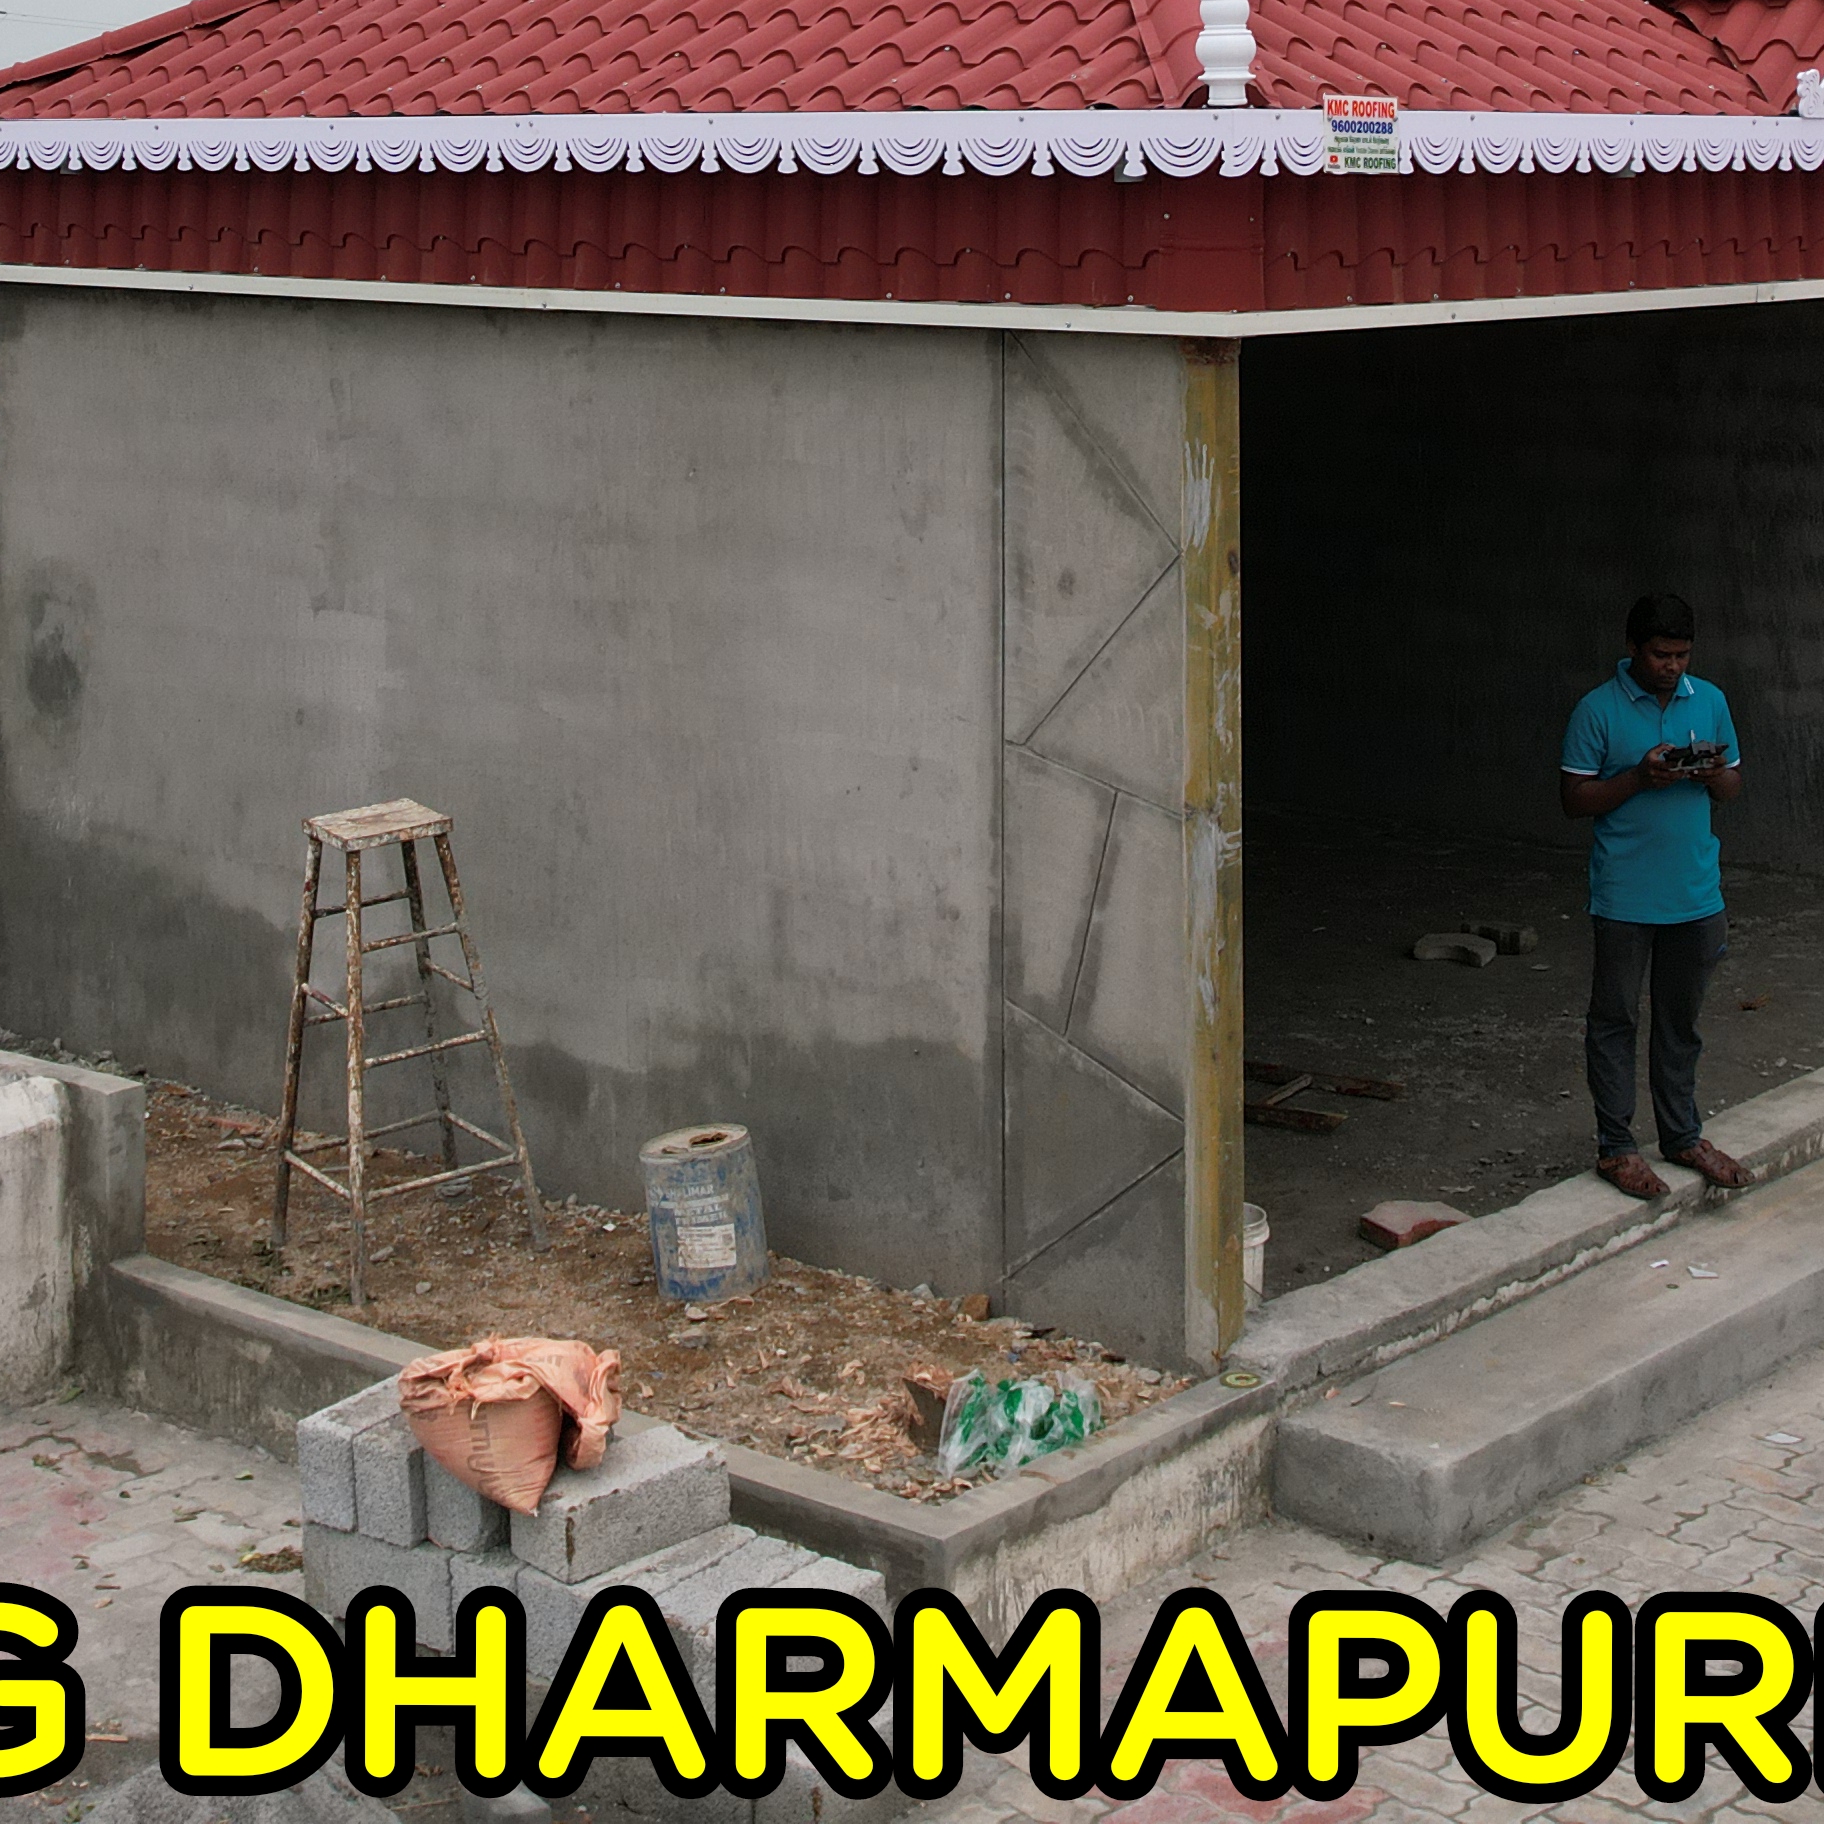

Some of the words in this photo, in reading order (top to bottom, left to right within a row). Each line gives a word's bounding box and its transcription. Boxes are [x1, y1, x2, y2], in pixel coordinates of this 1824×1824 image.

[1327, 99, 1349, 117] KMC
[1352, 100, 1395, 119] ROOFING
[1331, 119, 1394, 134] 9600200288
[1344, 156, 1361, 169] KMC
[1363, 157, 1396, 170] ROOFING
